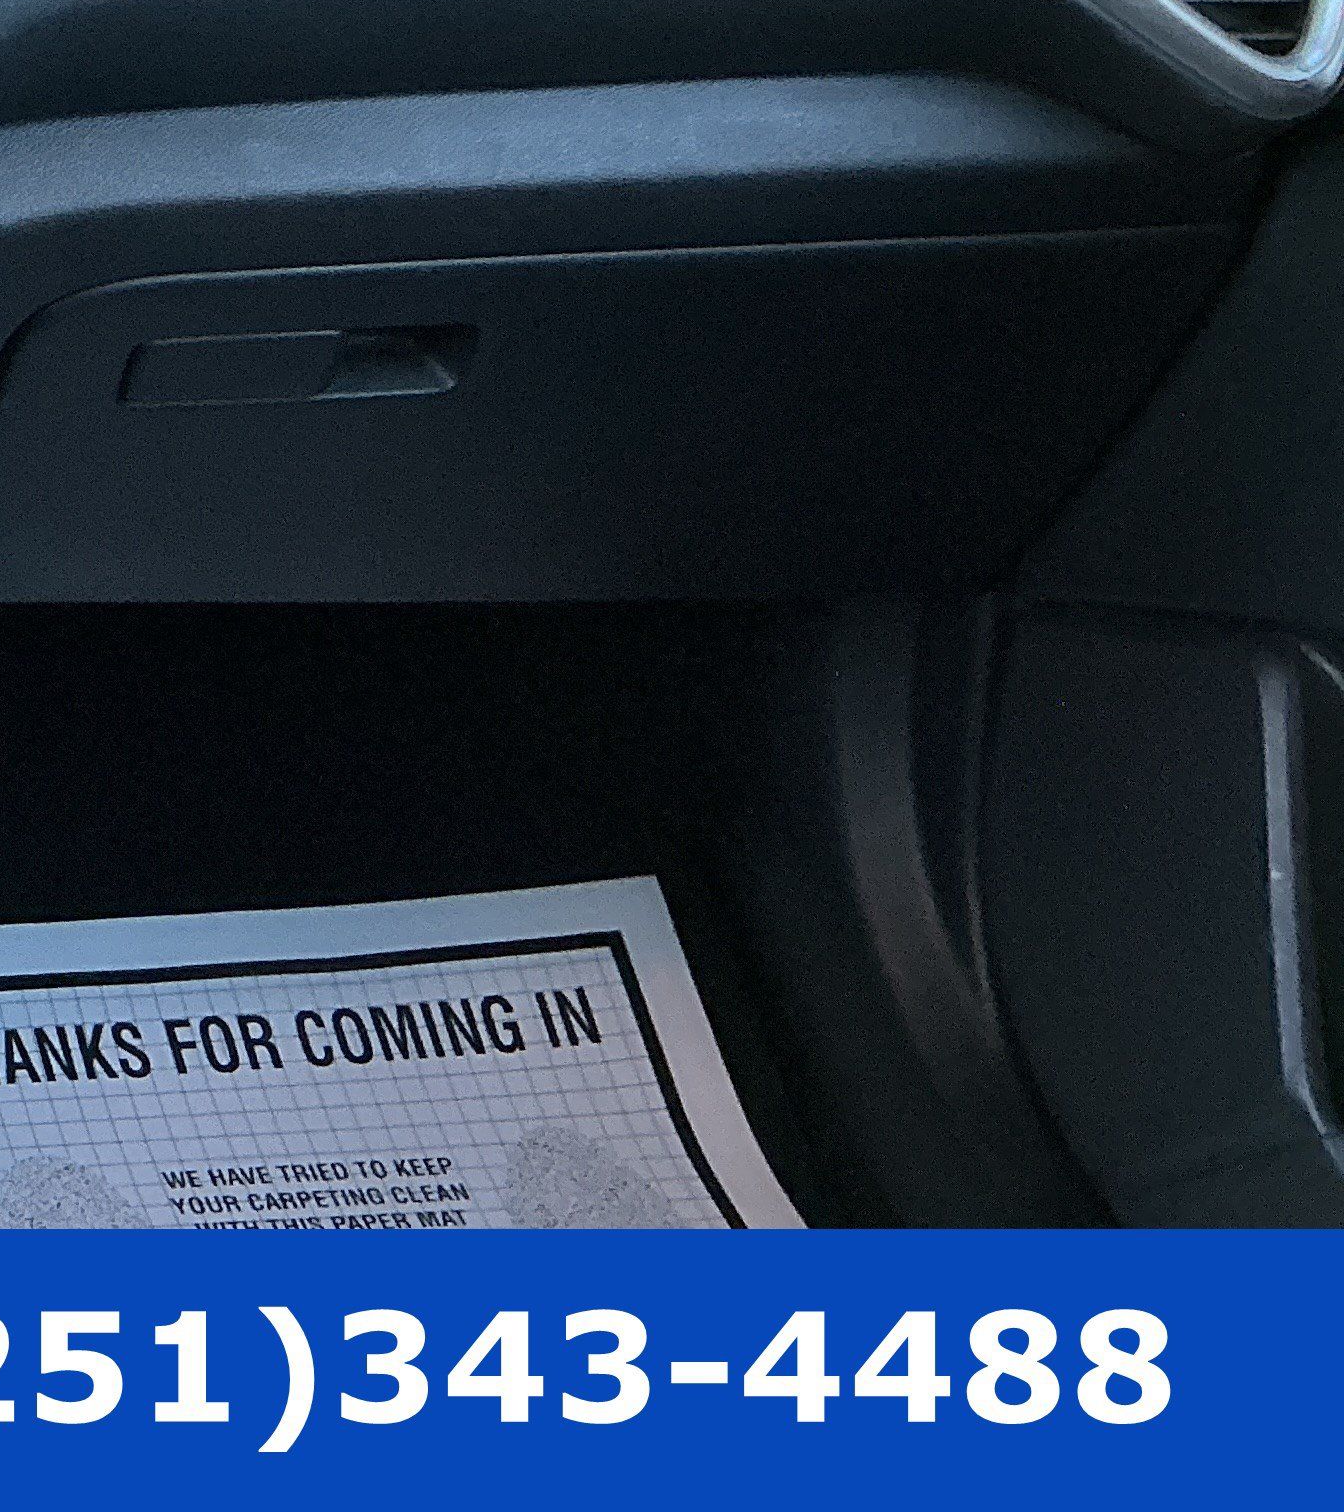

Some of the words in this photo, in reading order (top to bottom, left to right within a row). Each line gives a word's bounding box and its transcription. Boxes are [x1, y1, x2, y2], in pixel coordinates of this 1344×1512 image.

[163, 1014, 284, 1075] FOR
[294, 994, 526, 1068] COMING
[535, 985, 602, 1048] IN
[162, 1170, 203, 1190] WE
[208, 1166, 273, 1188] HAVE
[275, 1161, 350, 1185] TRIED
[354, 1159, 388, 1180] TO
[393, 1156, 453, 1178] KEEP
[170, 1194, 242, 1215] YOUR
[247, 1186, 386, 1213] CARPETING
[391, 1182, 471, 1205] CLEAN
[330, 1211, 412, 1229] PAPER
[416, 1209, 468, 1228] MAT
